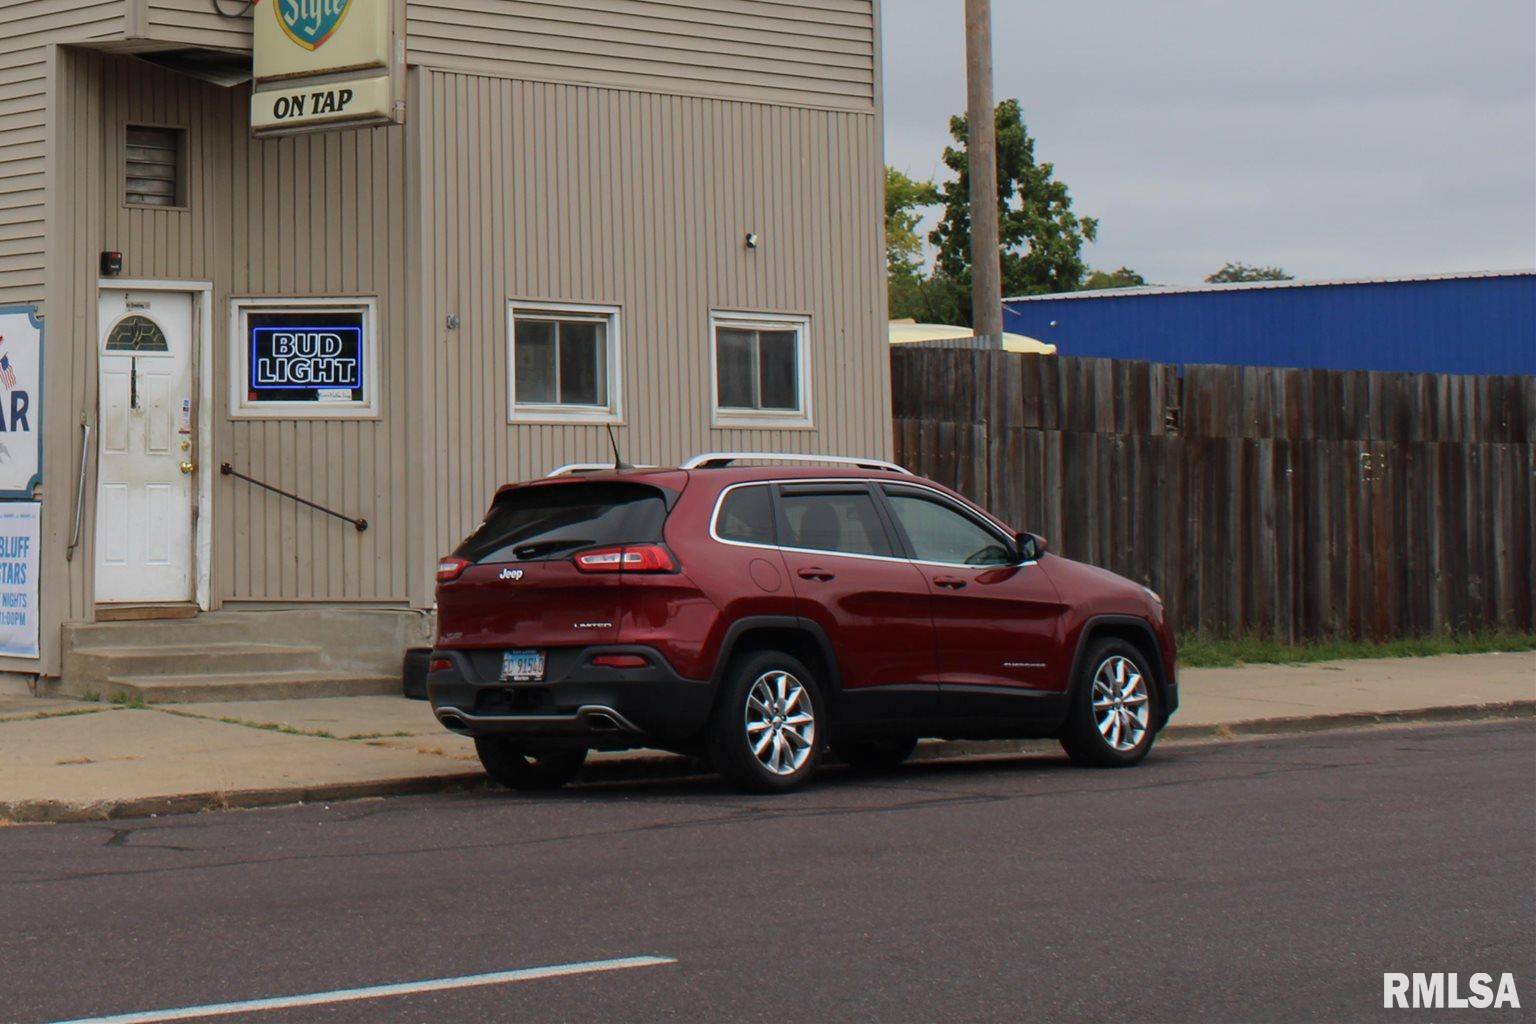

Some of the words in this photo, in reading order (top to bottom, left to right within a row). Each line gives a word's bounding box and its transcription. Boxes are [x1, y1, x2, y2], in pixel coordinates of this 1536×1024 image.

[273, 93, 306, 120] ON
[310, 88, 353, 115] TAP
[272, 332, 343, 358] BUD
[499, 568, 523, 580] Jeep
[2, 592, 27, 608] NIGHTS
